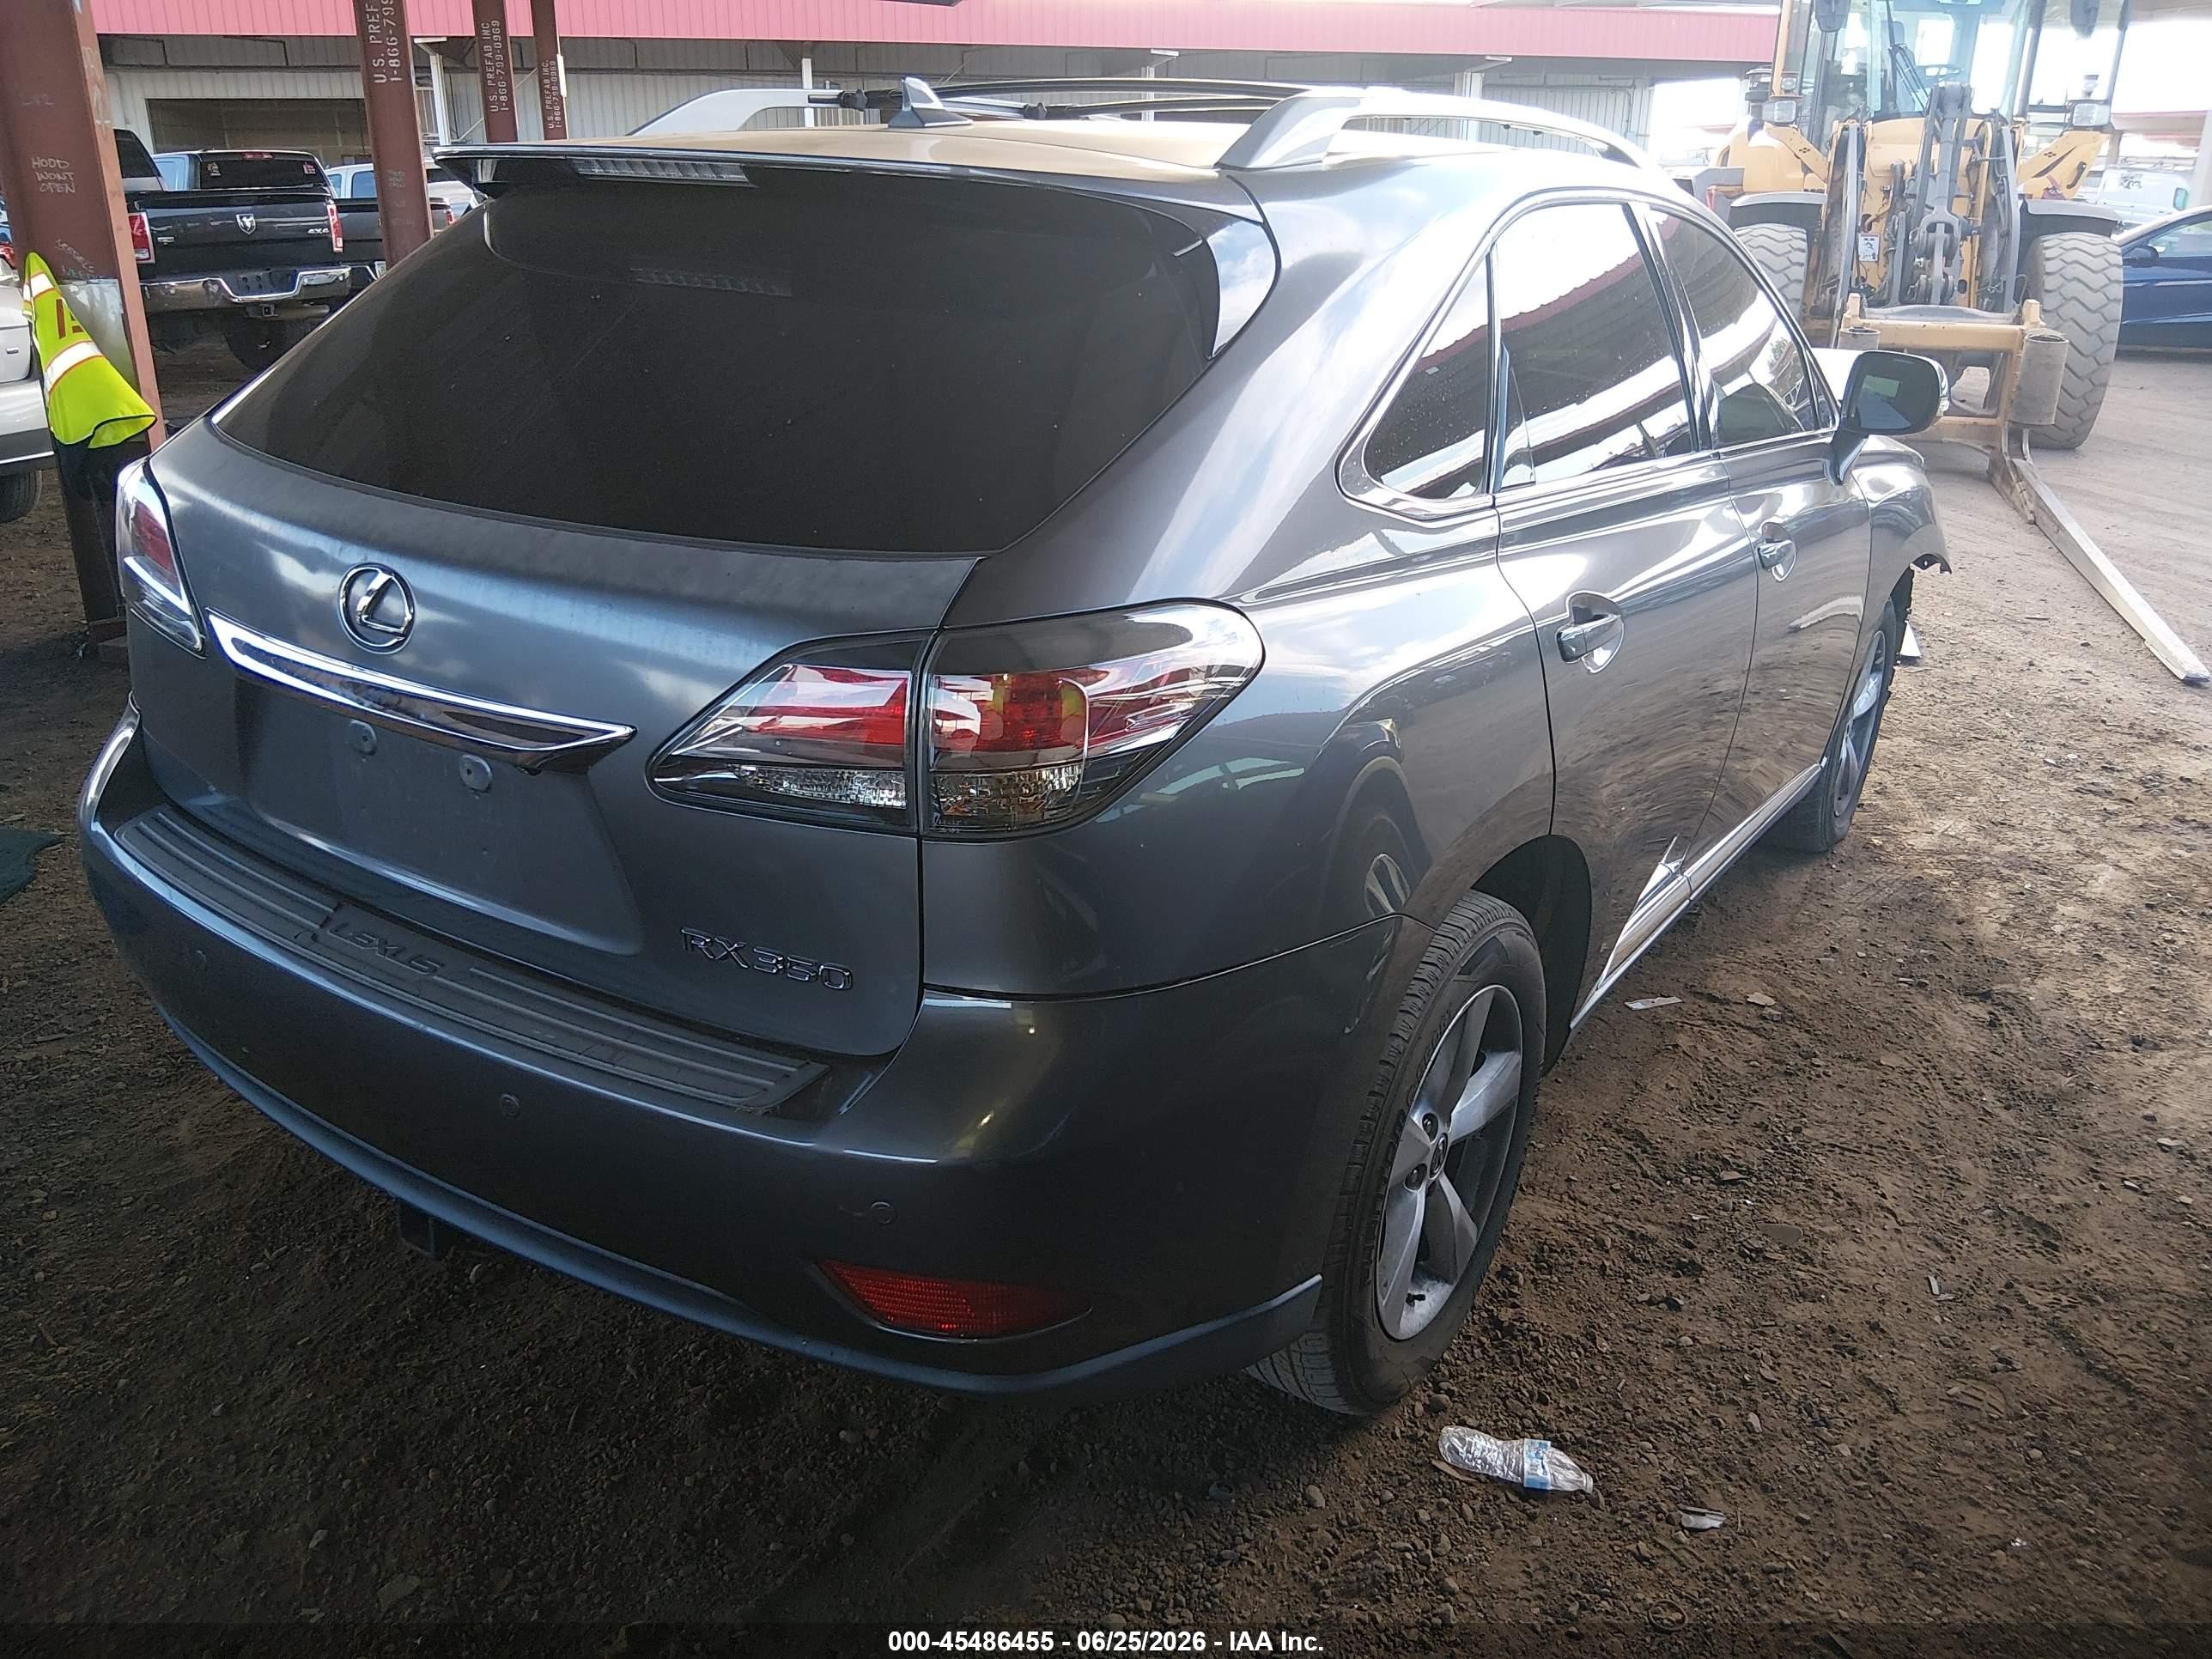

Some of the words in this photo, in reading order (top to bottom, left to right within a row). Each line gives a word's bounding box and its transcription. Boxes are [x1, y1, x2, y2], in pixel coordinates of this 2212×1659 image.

[373, 53, 386, 83] U.S.
[483, 45, 497, 87] PREFAB
[491, 20, 510, 111] 1-866-799-0969
[489, 92, 500, 112] U.S.
[543, 79, 554, 110] PREFAB
[31, 156, 70, 169] HOOD
[35, 171, 75, 181] WONT
[40, 182, 76, 193] OPEN
[329, 922, 445, 975] LEXUS
